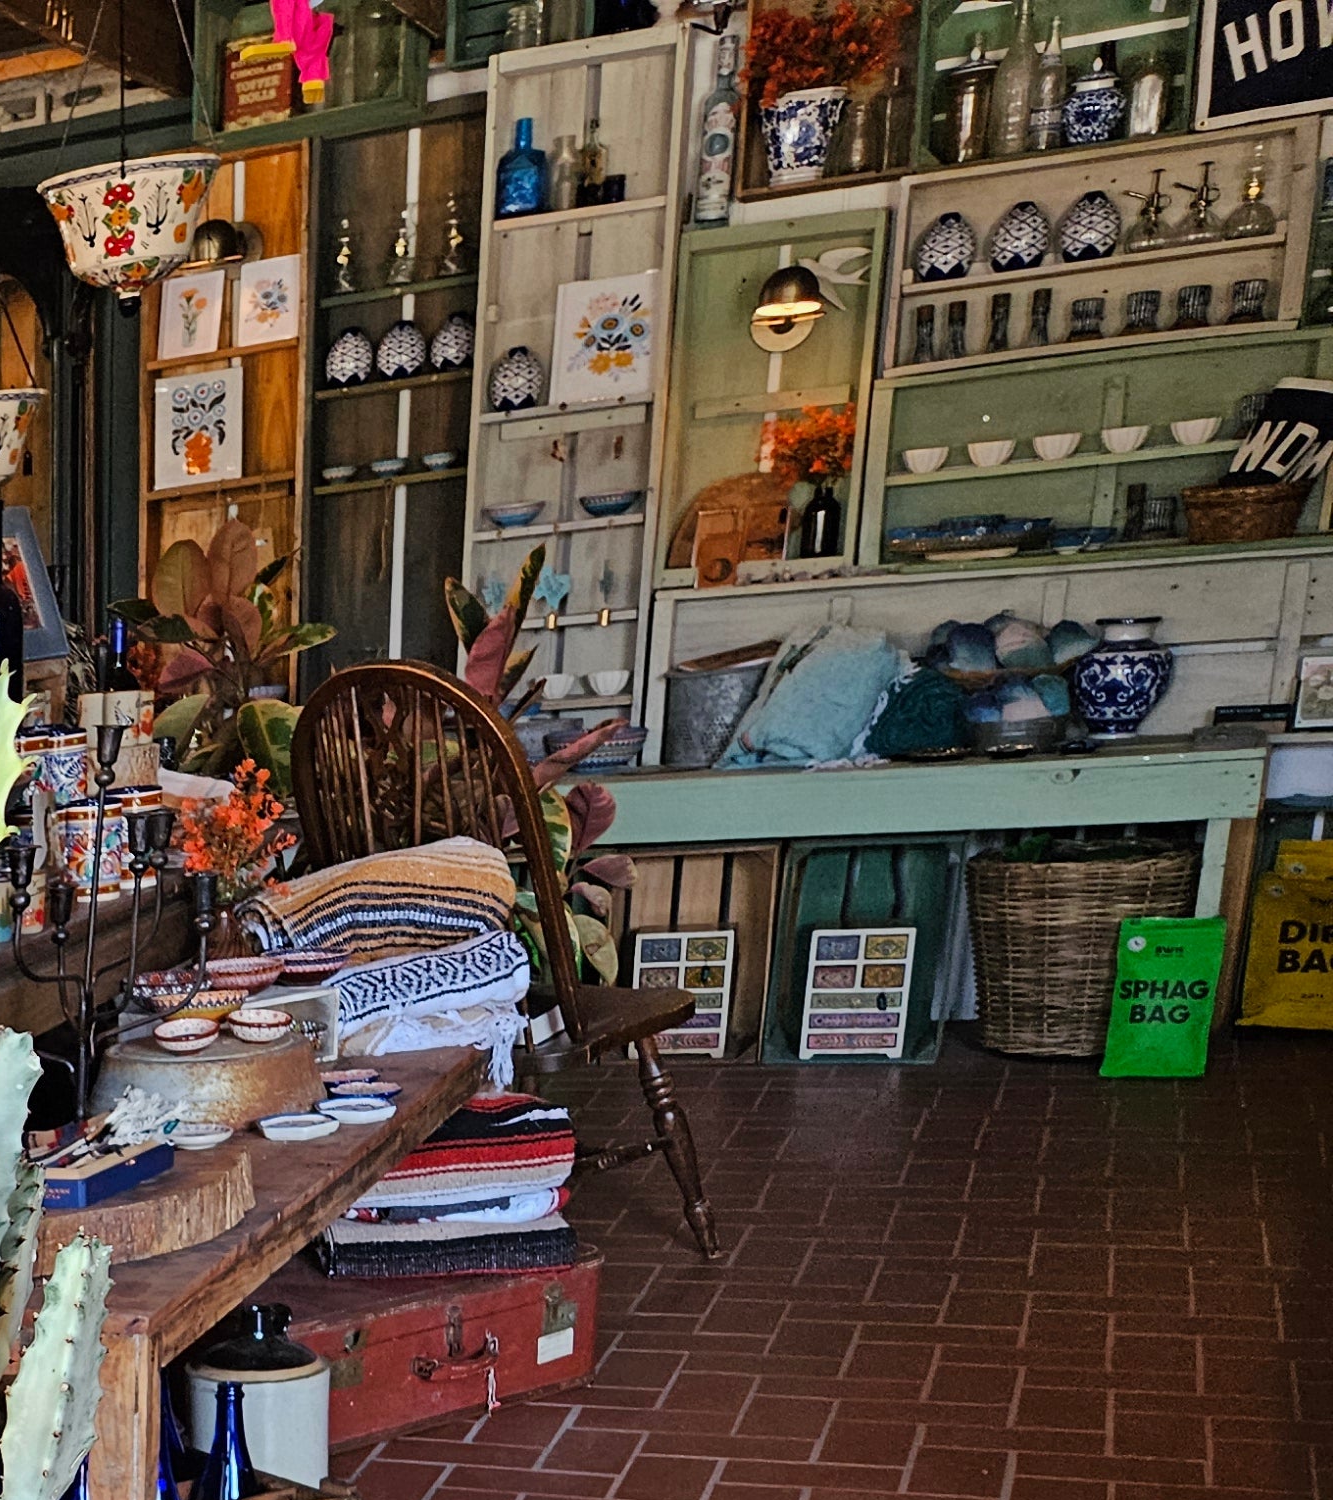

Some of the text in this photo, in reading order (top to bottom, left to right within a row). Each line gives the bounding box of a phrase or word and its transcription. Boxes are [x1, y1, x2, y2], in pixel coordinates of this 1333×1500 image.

[1277, 948, 1333, 974] BA
[1119, 979, 1210, 1001] SPHAG
[1129, 1004, 1191, 1025] BAG
